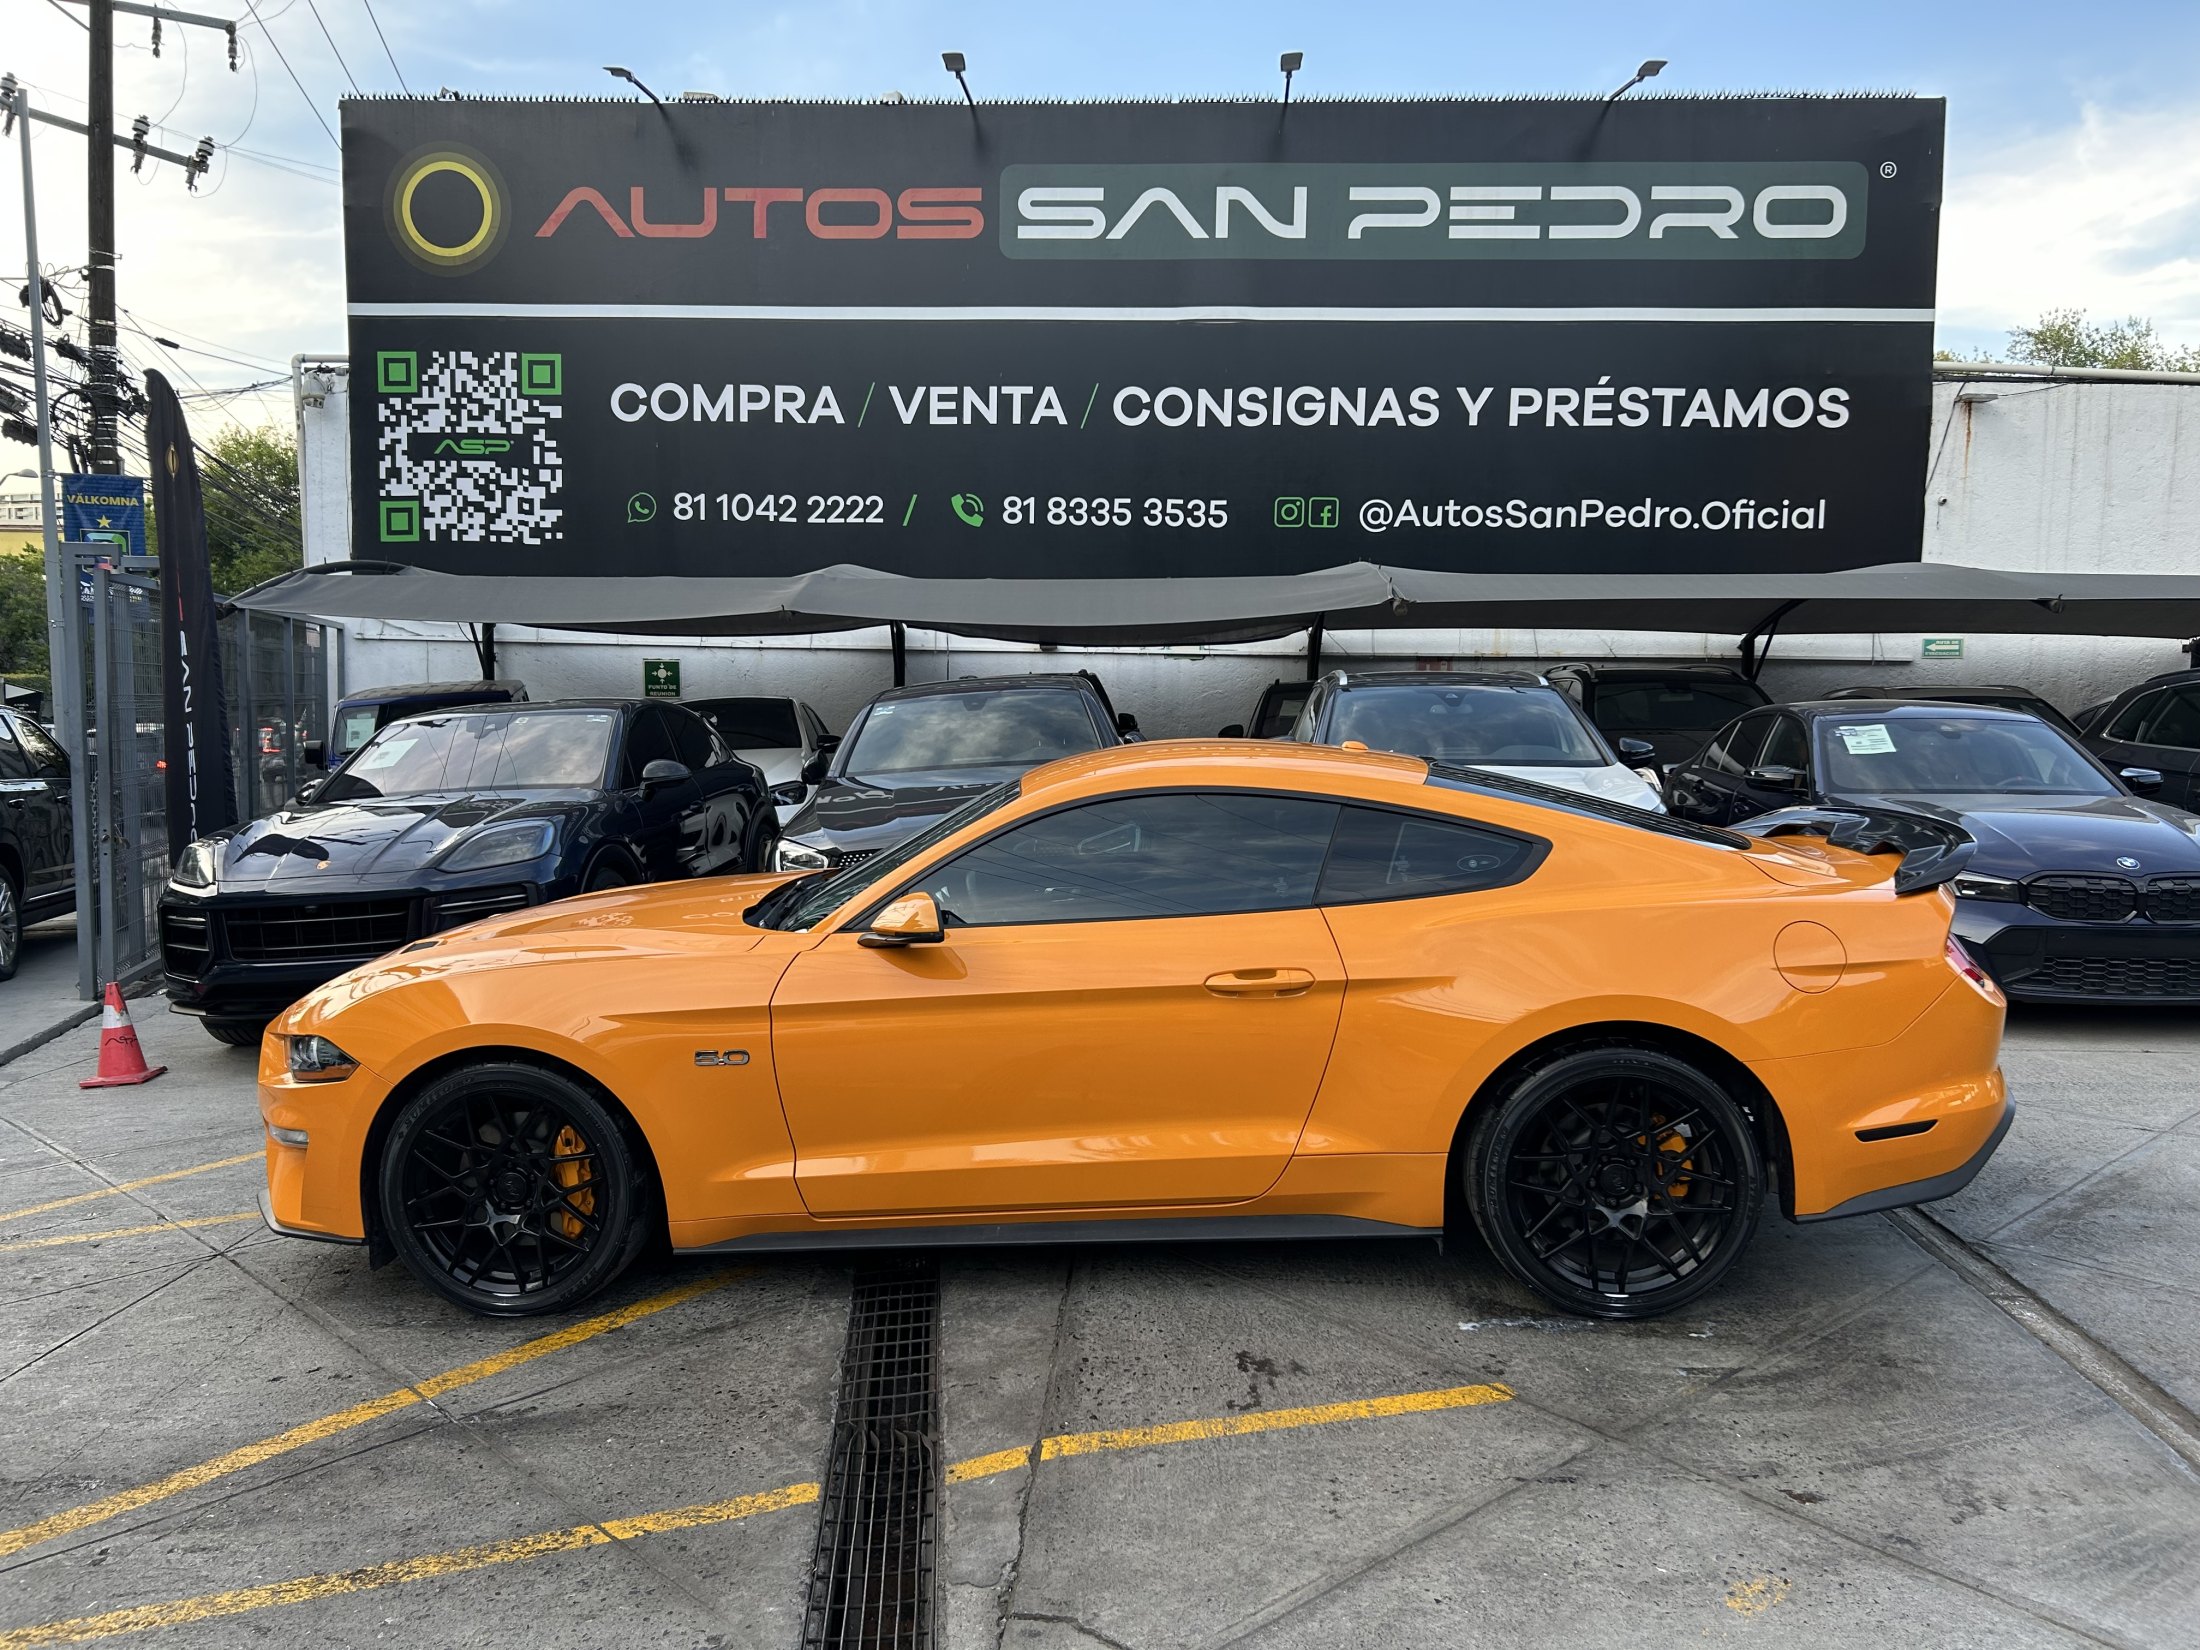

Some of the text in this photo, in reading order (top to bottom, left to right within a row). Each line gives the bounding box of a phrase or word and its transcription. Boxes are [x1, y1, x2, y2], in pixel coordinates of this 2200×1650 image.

[535, 186, 984, 239] AUTOS
[1017, 186, 1308, 240] SAN
[1347, 185, 1848, 240] PEDRO
[610, 382, 846, 424] COMPRA
[888, 385, 1068, 425] VENTA
[1112, 385, 1440, 428] CONSIGNAS
[1456, 386, 1495, 426] Y
[1508, 375, 1850, 429] PRÉSTAMOS
[434, 439, 511, 455] ASP
[66, 492, 140, 507] VÄLKOMNA
[673, 492, 706, 521] 81
[716, 493, 797, 523] 1042
[806, 495, 884, 524] 2222
[1002, 495, 1228, 528] 81 8335 3535
[1359, 497, 1827, 533] @AutosSanPedro.Oficial
[694, 1048, 751, 1067] 5.0
